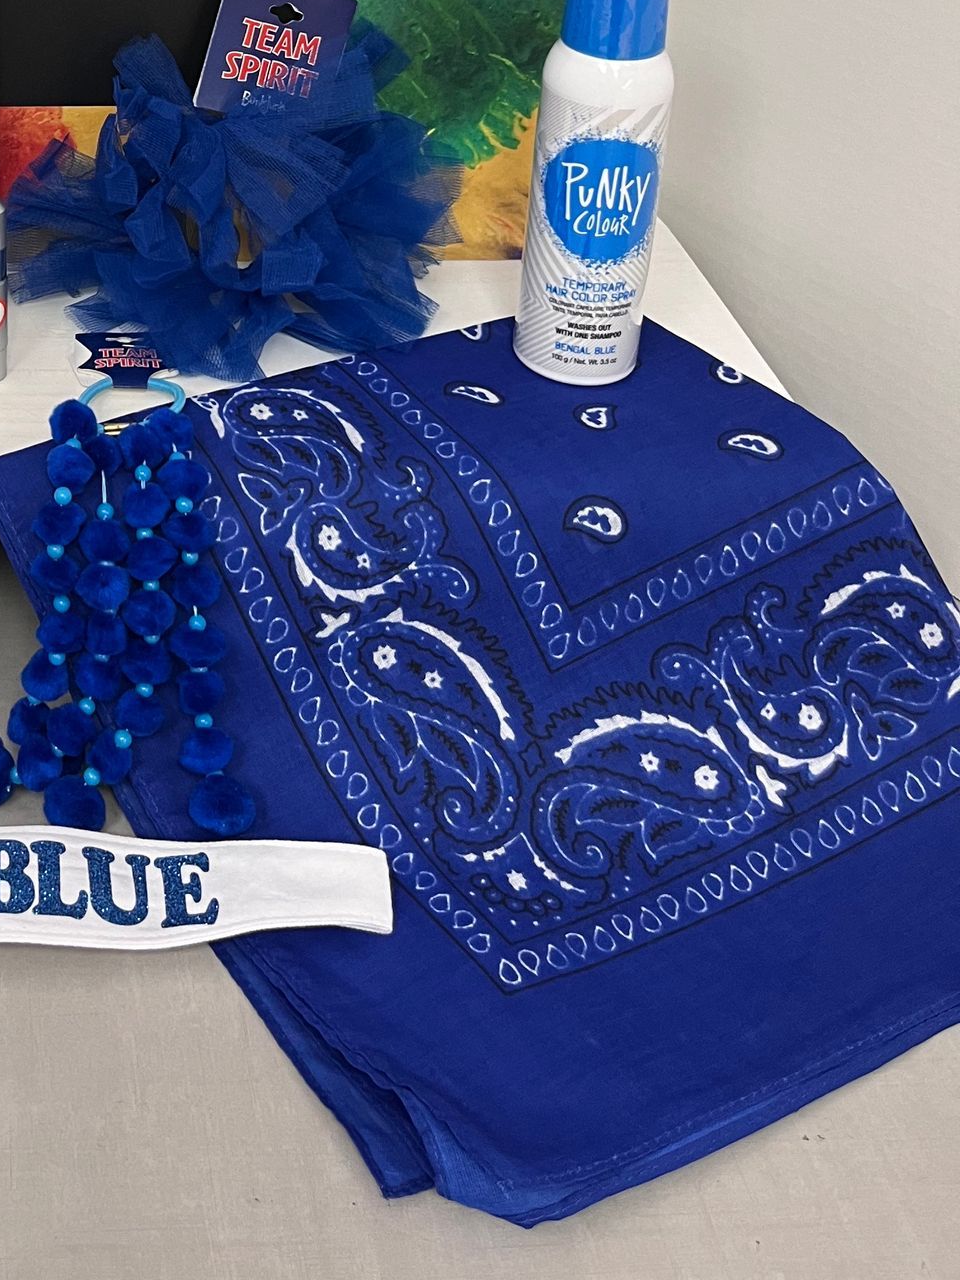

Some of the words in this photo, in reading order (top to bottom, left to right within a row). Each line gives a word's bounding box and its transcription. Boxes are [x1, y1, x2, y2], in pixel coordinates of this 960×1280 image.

[242, 17, 322, 66] TEAM
[221, 51, 320, 98] SPIRIT
[563, 277, 627, 292] TEMPORARY
[545, 282, 568, 298] HAIR
[571, 291, 608, 303] COLOR
[611, 289, 636, 302] SPRAY
[555, 327, 573, 337] WITH
[574, 331, 589, 339] ONE
[590, 331, 622, 340] SHAMPOO
[567, 322, 597, 332] WASHES
[598, 324, 612, 332] OUT
[98, 348, 158, 358] TEAM
[554, 341, 591, 355] BENGAL
[594, 345, 617, 355] BLUE
[94, 358, 162, 369] SPIRIT
